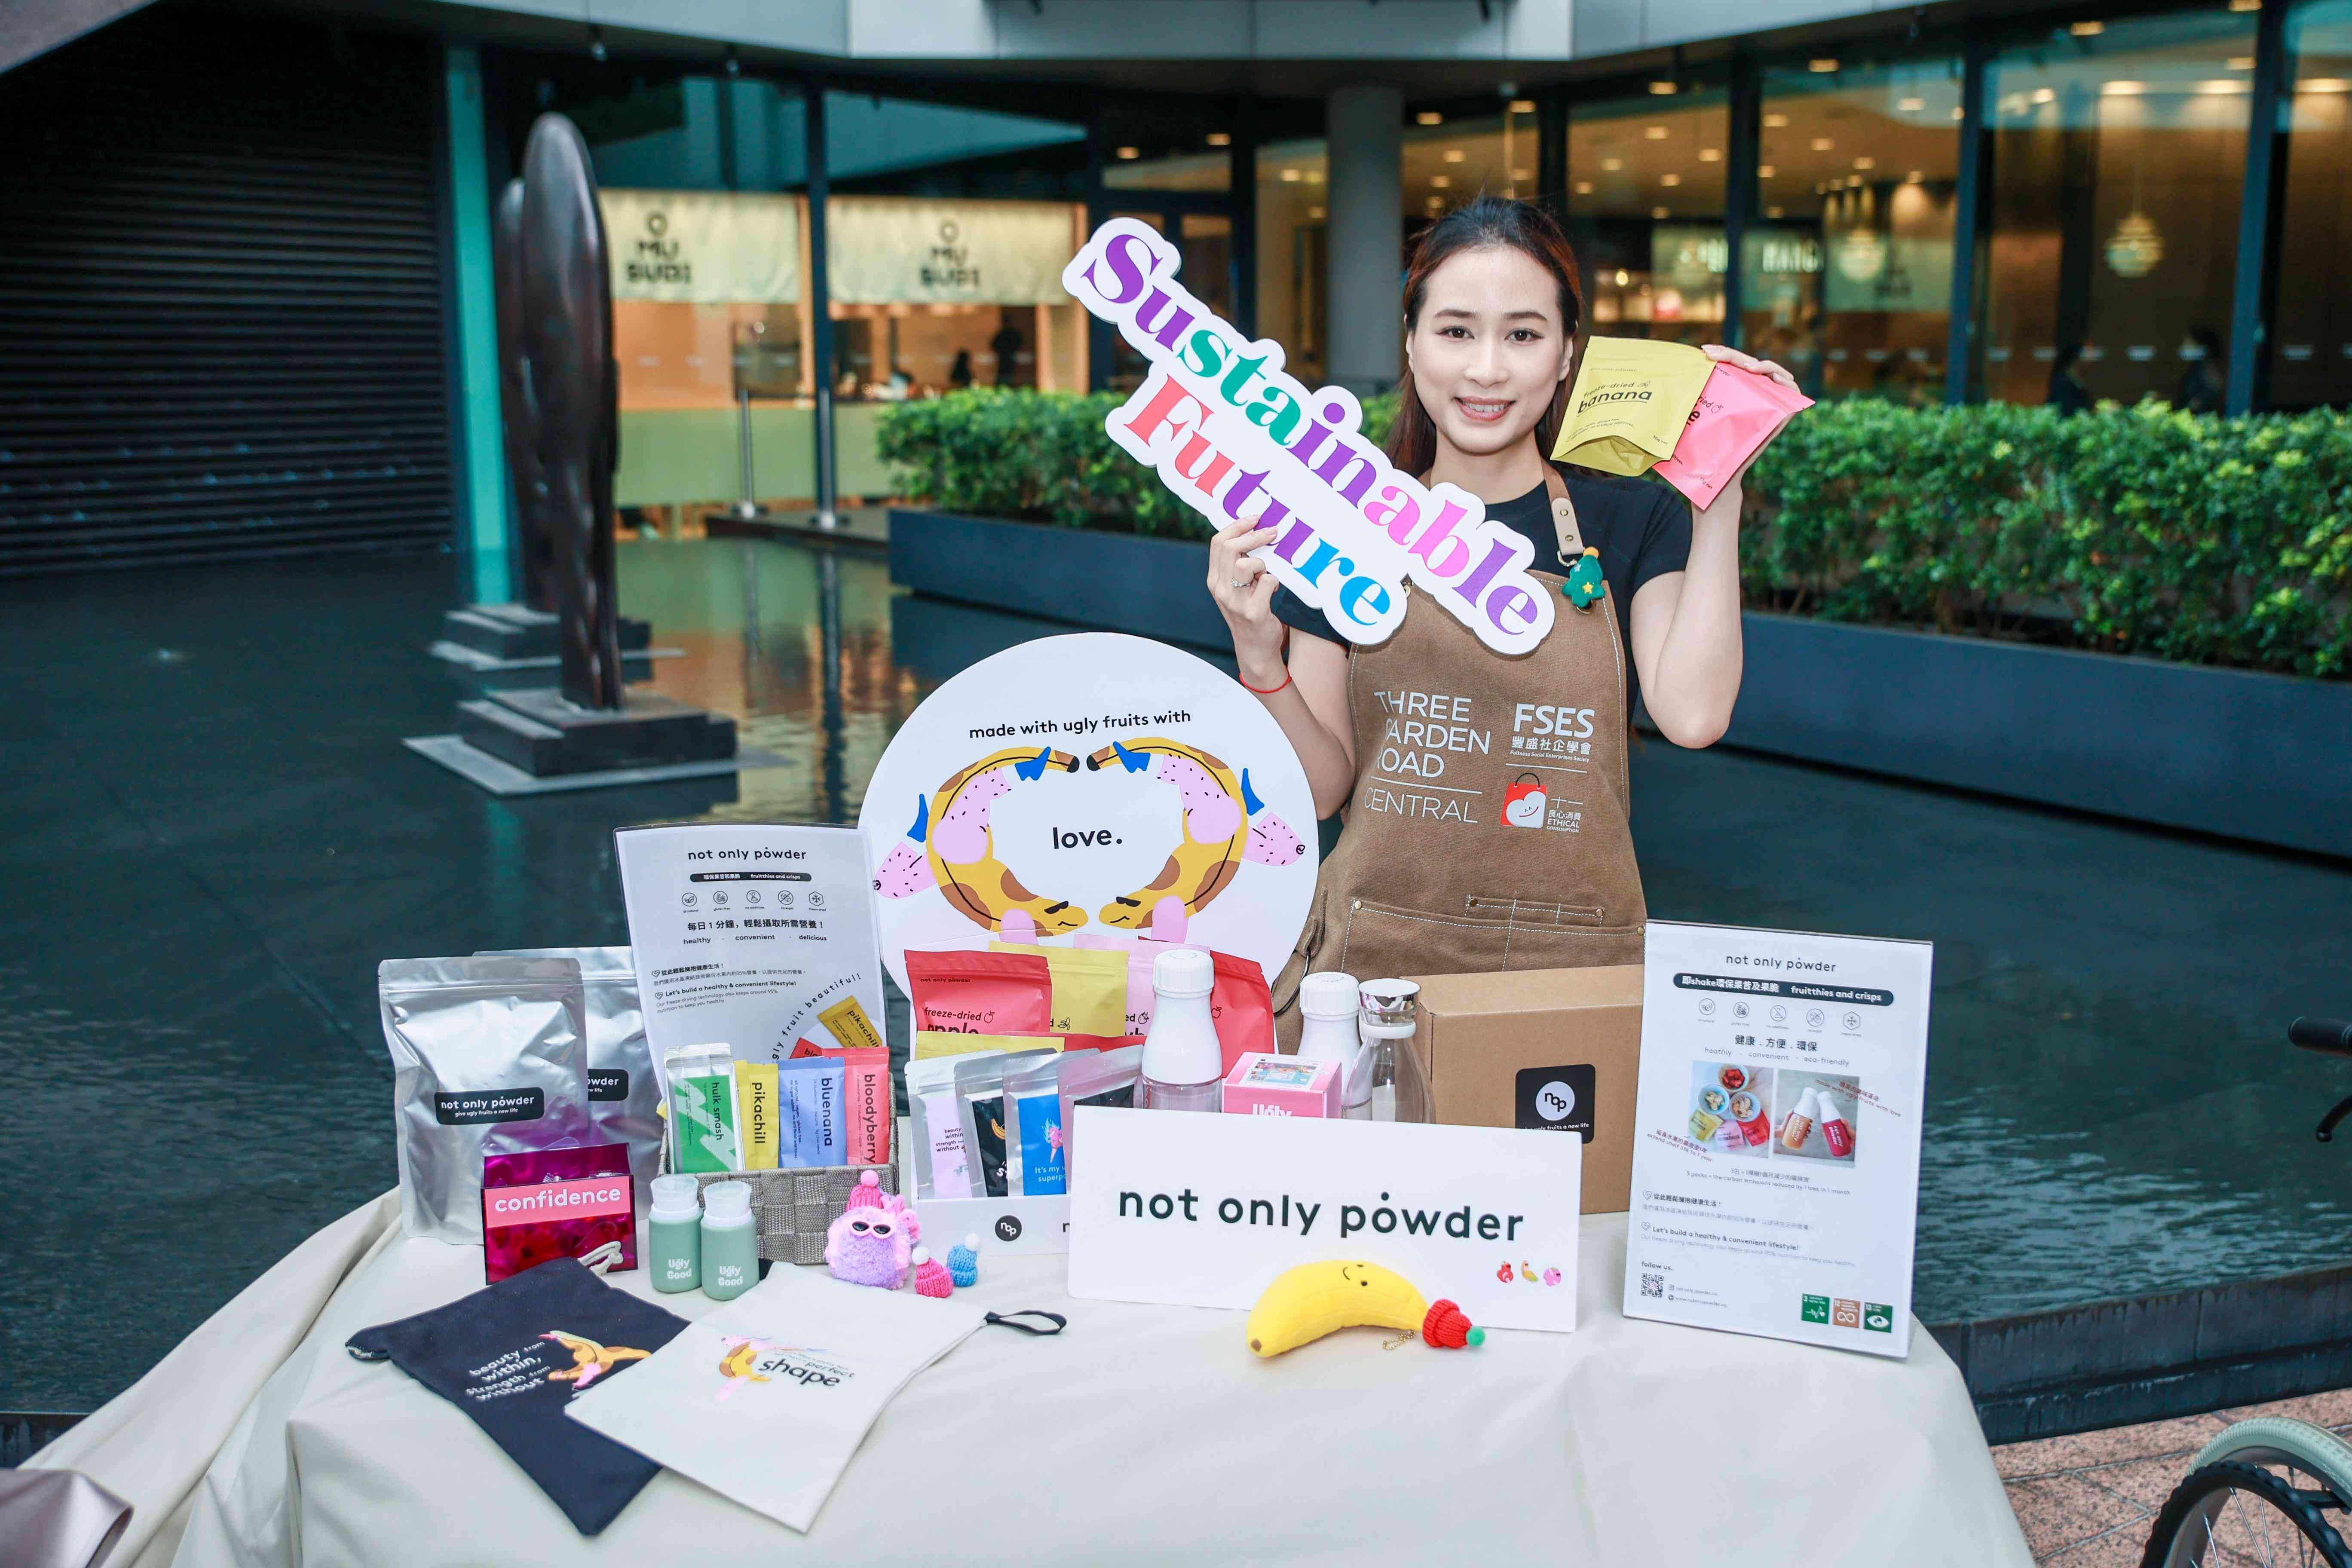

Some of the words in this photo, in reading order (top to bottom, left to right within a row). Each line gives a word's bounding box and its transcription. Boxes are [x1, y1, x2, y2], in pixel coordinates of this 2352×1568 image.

[1584, 383, 1635, 398] freeze-dried
[1577, 392, 1652, 414] banana
[1081, 234, 1538, 634] Sustainable
[1124, 376, 1390, 625] Future
[1374, 691, 1472, 723] THREE
[968, 723, 1016, 739] made
[1020, 719, 1058, 735] with
[1063, 716, 1098, 735] ugly
[1102, 713, 1149, 731] fruits
[1153, 709, 1191, 725] with
[1513, 703, 1595, 738] FSES
[1512, 736, 1591, 755] 豐盛社企學會
[1365, 787, 1478, 823] CENTRAL
[1549, 810, 1581, 821] 良心消費
[1547, 818, 1580, 828] ETHICAL
[1053, 827, 1123, 849] love.
[688, 850, 713, 859] not
[719, 849, 748, 860] only
[1726, 955, 1748, 965] not
[1754, 957, 1782, 970] only
[782, 1011, 804, 1036] fruit
[805, 973, 861, 1008] beautiful!
[1790, 986, 1833, 997] fruitthies
[1835, 990, 1853, 998] and
[1855, 992, 1882, 1002] crisps
[925, 1007, 982, 1021] freeze-dried
[1749, 1051, 1789, 1061] convenient
[1804, 1055, 1850, 1067] eco-friendly
[441, 1100, 459, 1109] not
[465, 1099, 488, 1109] only
[712, 1082, 721, 1104] hulk
[1544, 1093, 1566, 1112] nop
[1815, 1079, 1830, 1087] made
[1859, 1096, 1874, 1106] fruits
[1876, 1103, 1888, 1112] with
[714, 1108, 724, 1140] smash
[752, 1082, 766, 1143] pikachill
[822, 1078, 833, 1146] bluenana
[863, 1074, 877, 1163] bloodyberry
[1647, 1133, 1665, 1142] extend
[1666, 1138, 1679, 1148] shelf
[1701, 1154, 1713, 1162] year
[495, 1186, 622, 1213] confidence
[1119, 1188, 1197, 1221] not
[1219, 1193, 1321, 1235] only
[1670, 1228, 1687, 1237] build
[1695, 1231, 1720, 1242] healthy
[1729, 1237, 1767, 1246] convenient
[1768, 1241, 1799, 1251] lifestyle!
[667, 1268, 692, 1279] Good
[1642, 1261, 1661, 1269] follow
[718, 1276, 743, 1286] Good
[469, 1351, 520, 1377] beauty
[523, 1341, 545, 1353] from
[481, 1357, 542, 1383] within,
[805, 1362, 855, 1378] perfect
[466, 1375, 526, 1396] strength
[529, 1366, 550, 1376] from
[758, 1358, 840, 1387] shape
[475, 1377, 545, 1401] without
